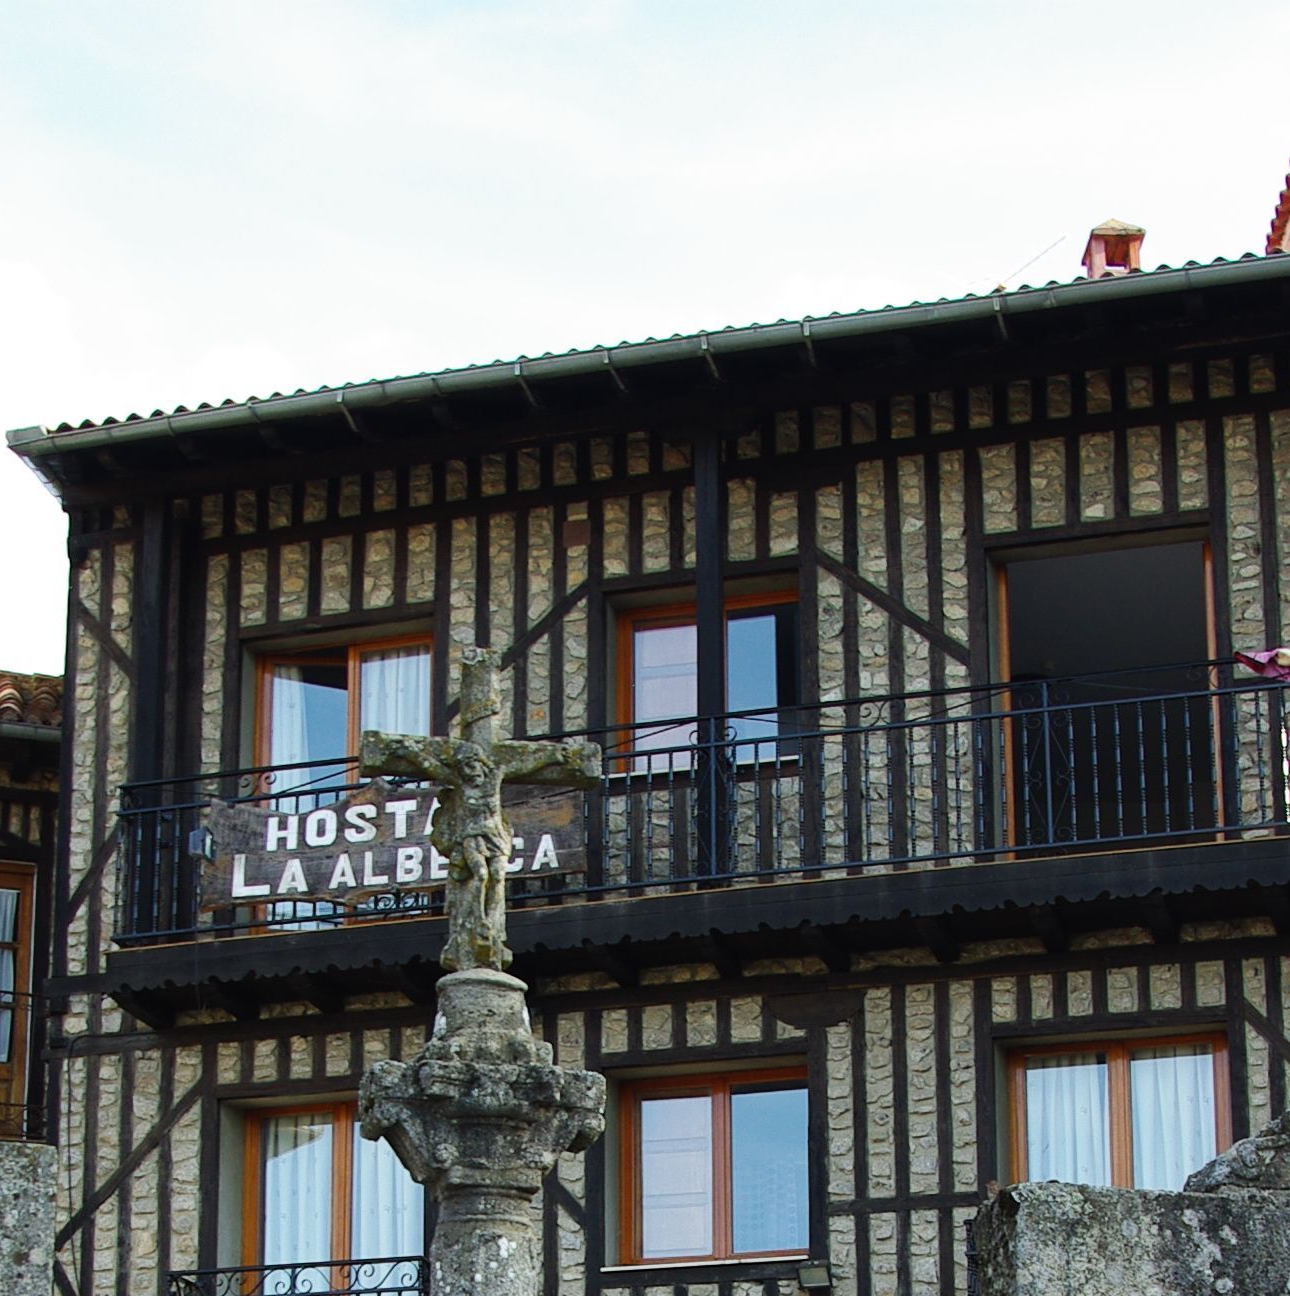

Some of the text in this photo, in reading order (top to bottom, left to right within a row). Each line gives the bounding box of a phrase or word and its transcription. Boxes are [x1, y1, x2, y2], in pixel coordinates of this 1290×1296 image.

[266, 798, 441, 852] HOST
[232, 834, 560, 898] LA ALBECA
